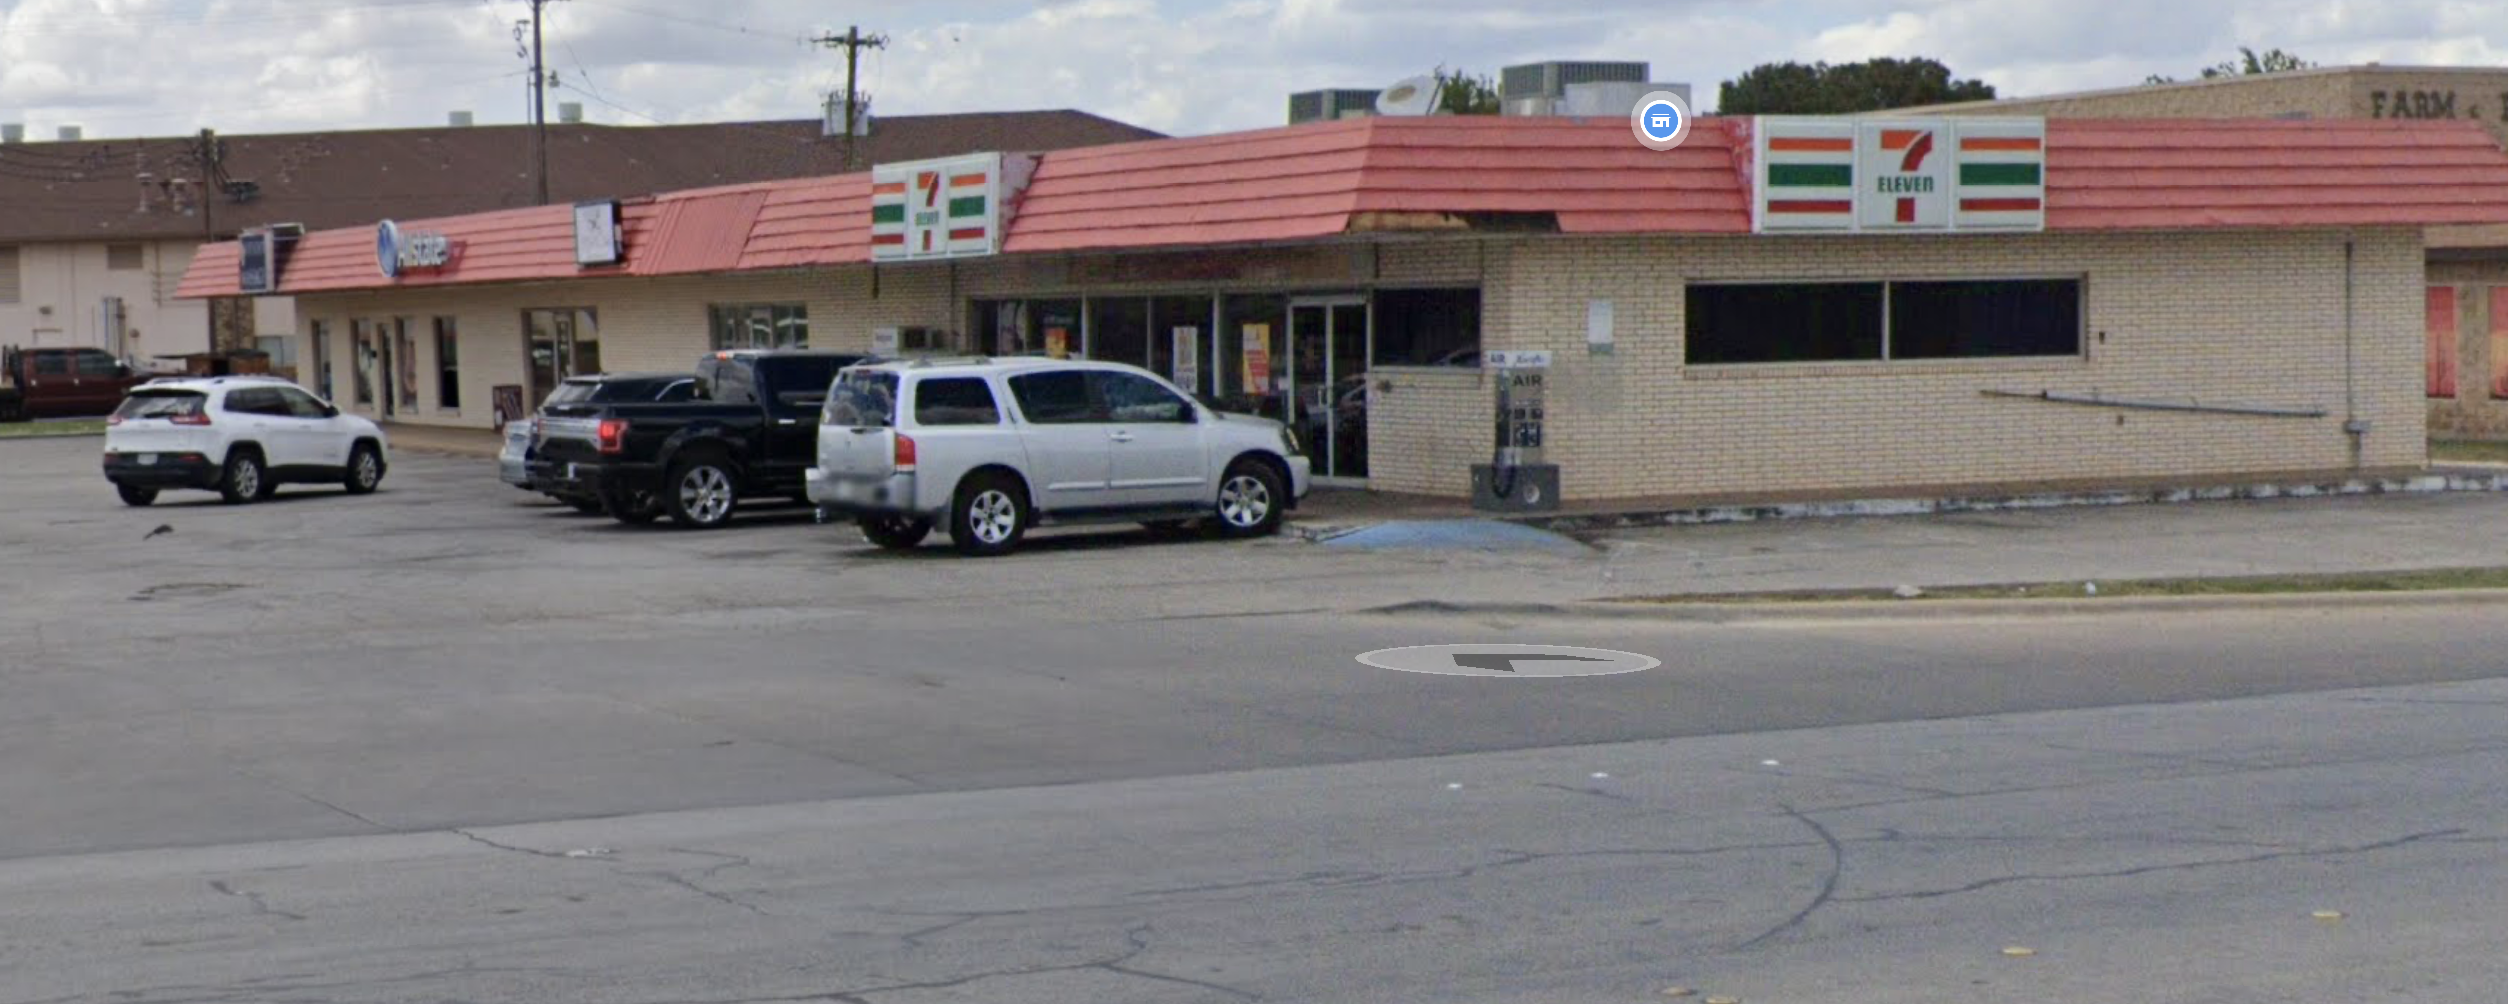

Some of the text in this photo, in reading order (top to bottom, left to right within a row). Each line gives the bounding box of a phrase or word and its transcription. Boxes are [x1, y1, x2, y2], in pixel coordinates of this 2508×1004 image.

[2370, 89, 2457, 119] FARM
[1880, 130, 1933, 222] 7
[917, 171, 940, 251] 7
[1511, 374, 1544, 387] AIR
